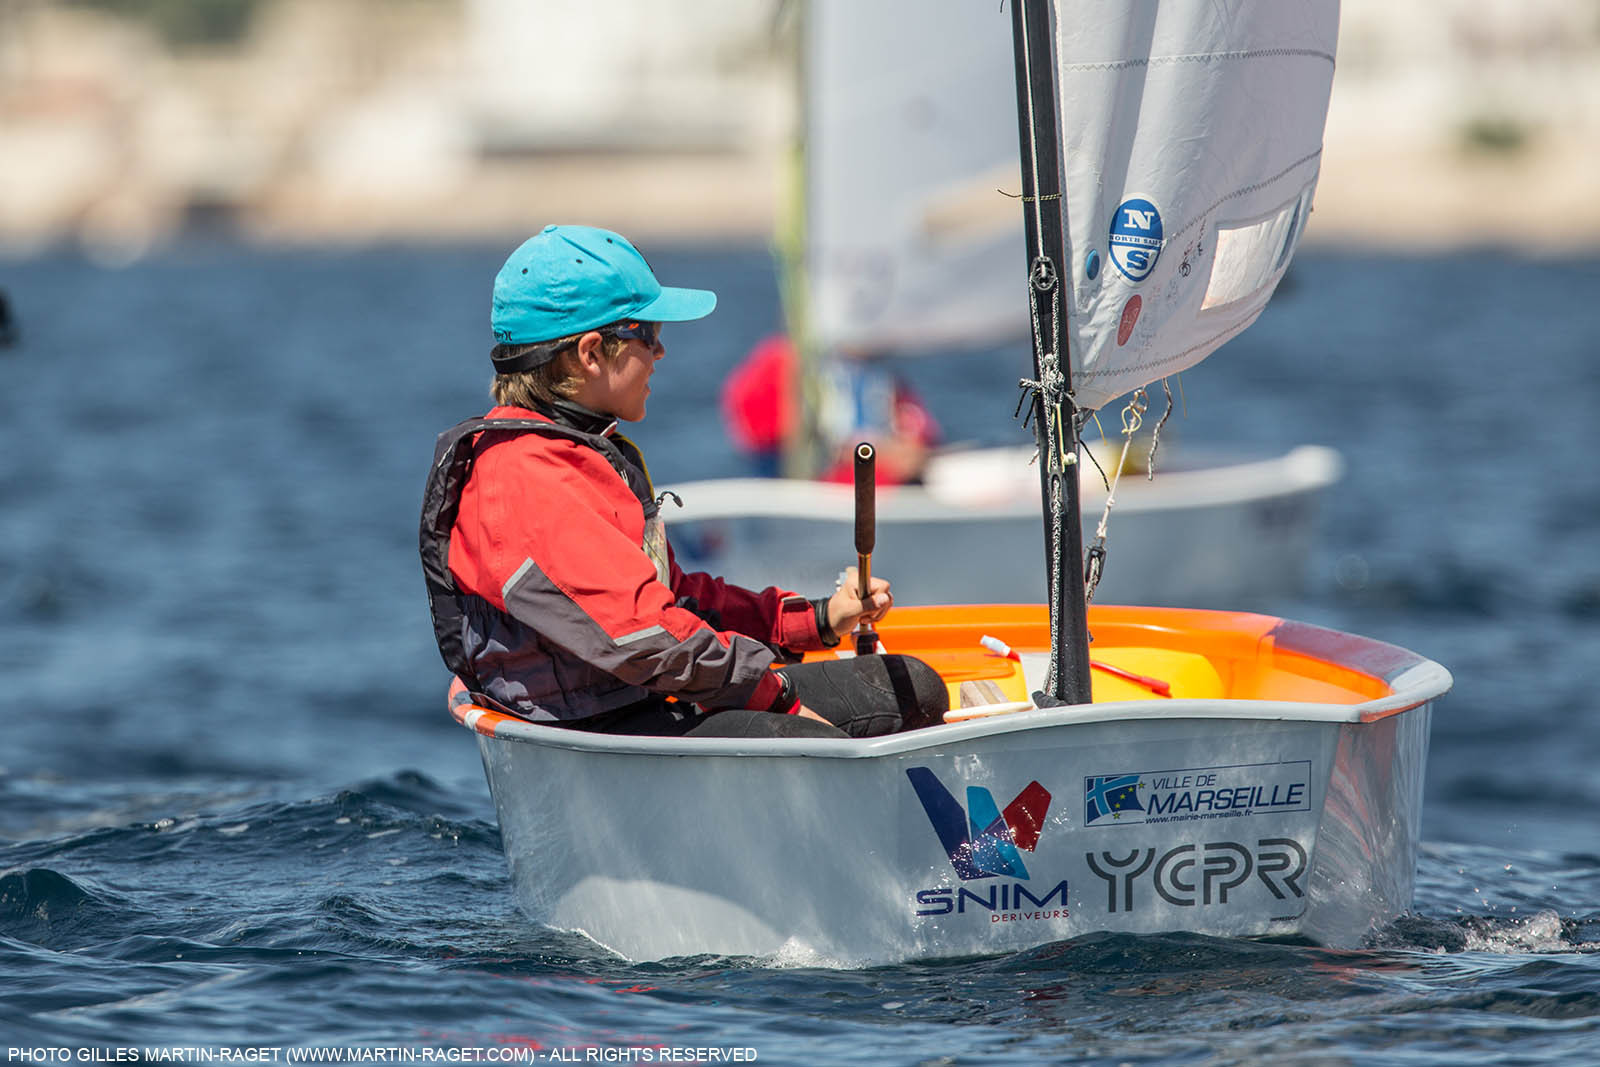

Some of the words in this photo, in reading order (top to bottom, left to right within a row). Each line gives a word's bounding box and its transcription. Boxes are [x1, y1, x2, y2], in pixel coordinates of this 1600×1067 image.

[1124, 209, 1155, 230] N
[1126, 250, 1150, 271] S
[1152, 775, 1192, 791] VILLE
[1195, 773, 1217, 787] DE
[1147, 783, 1305, 815] MARSEILLE
[1145, 809, 1253, 825] www.mairie-marseille.fr
[1086, 838, 1307, 914] YCPR
[916, 880, 1068, 916] SNIM
[991, 909, 1070, 923] DERIVEURS
